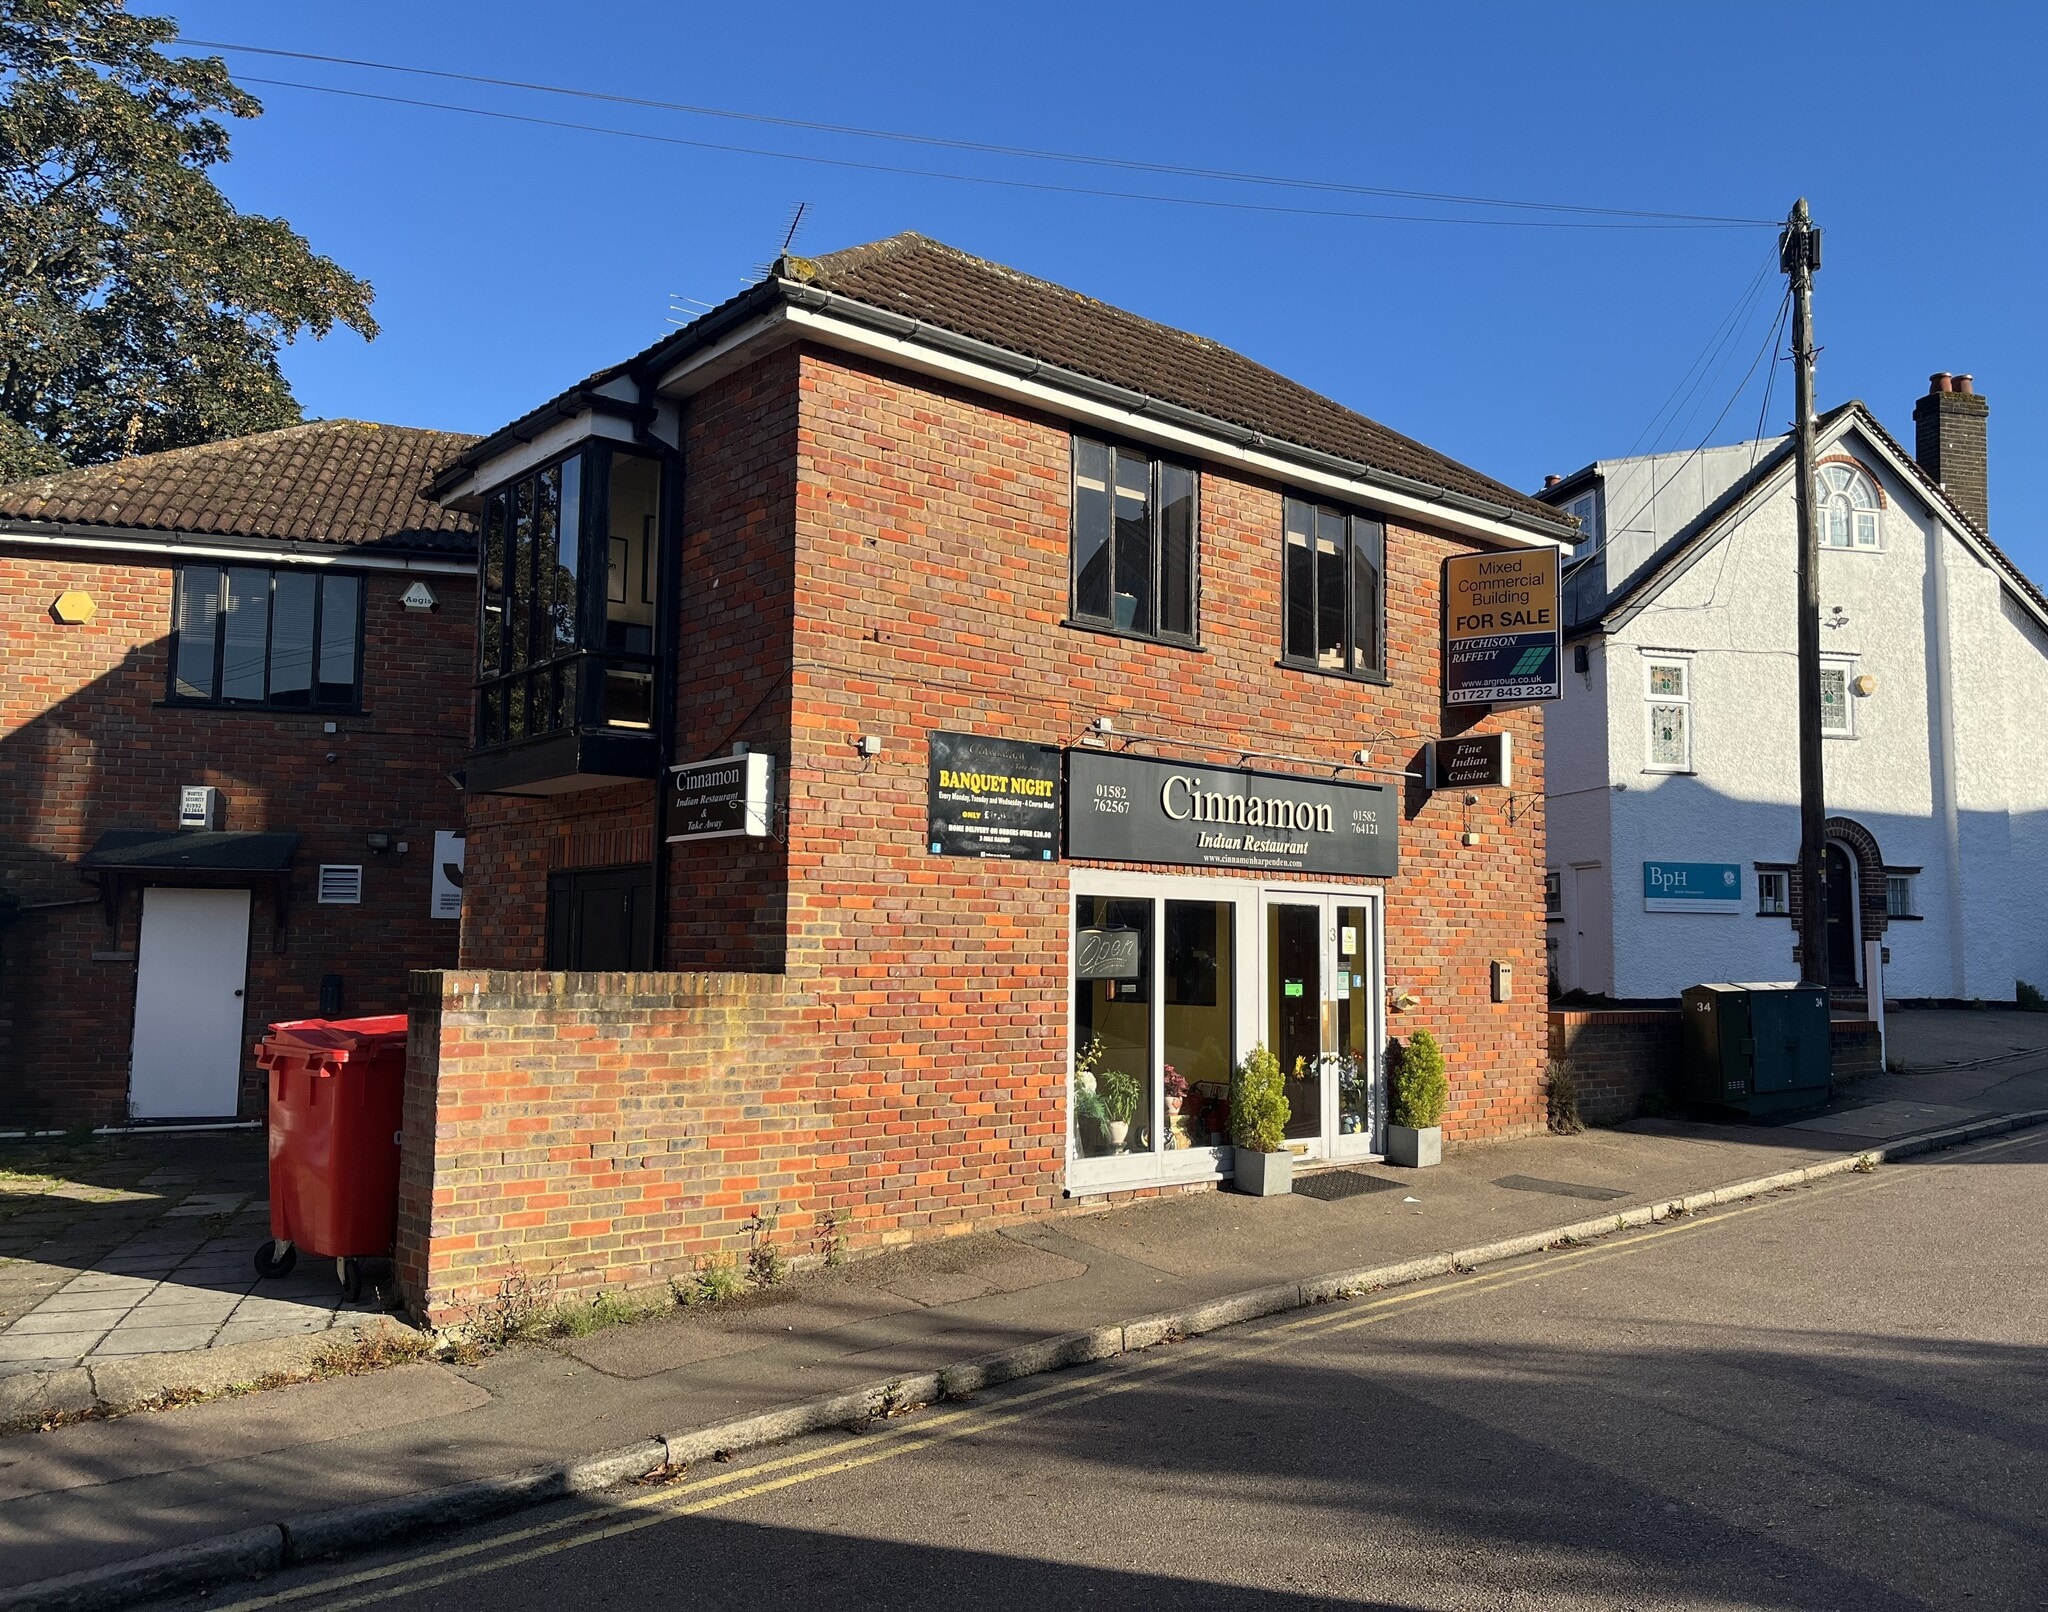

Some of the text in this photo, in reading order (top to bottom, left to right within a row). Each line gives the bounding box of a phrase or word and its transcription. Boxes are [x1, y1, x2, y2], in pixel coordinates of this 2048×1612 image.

[1479, 559, 1522, 575] Mixed
[1458, 573, 1544, 593] Commercial
[406, 597, 431, 605] Aegis
[1472, 591, 1530, 606] Building
[1456, 609, 1550, 631] FOR SALE
[1452, 636, 1518, 651] AITCHISON
[1452, 650, 1499, 663] RAFFETY
[1461, 675, 1542, 687] www.argroup.co.uk
[1452, 686, 1553, 701] 01727 843 232
[1457, 744, 1482, 755] Fine
[1451, 756, 1488, 767] Indian
[676, 768, 740, 792] Cinnamon
[1448, 770, 1490, 781] Cuisine
[939, 770, 1054, 797] BANQUET NIGHT
[1095, 783, 1127, 799] 01582
[676, 792, 739, 808] Indian Restaurant
[1093, 798, 1130, 815] 762567
[1162, 775, 1335, 833] Cinnamon
[700, 808, 708, 818] &
[961, 811, 981, 820] ONLY
[1352, 810, 1377, 822] 01582
[687, 819, 723, 831] Take Away
[1351, 823, 1379, 835] 764121
[1198, 831, 1309, 855] Indian Restaurant
[1203, 854, 1303, 868] www.cinnamonharpenden.com
[1650, 866, 1687, 892] BpH
[1329, 927, 1336, 942] 3
[1079, 935, 1135, 974] Open
[1696, 1002, 1711, 1012] 34
[1815, 998, 1823, 1007] 34
